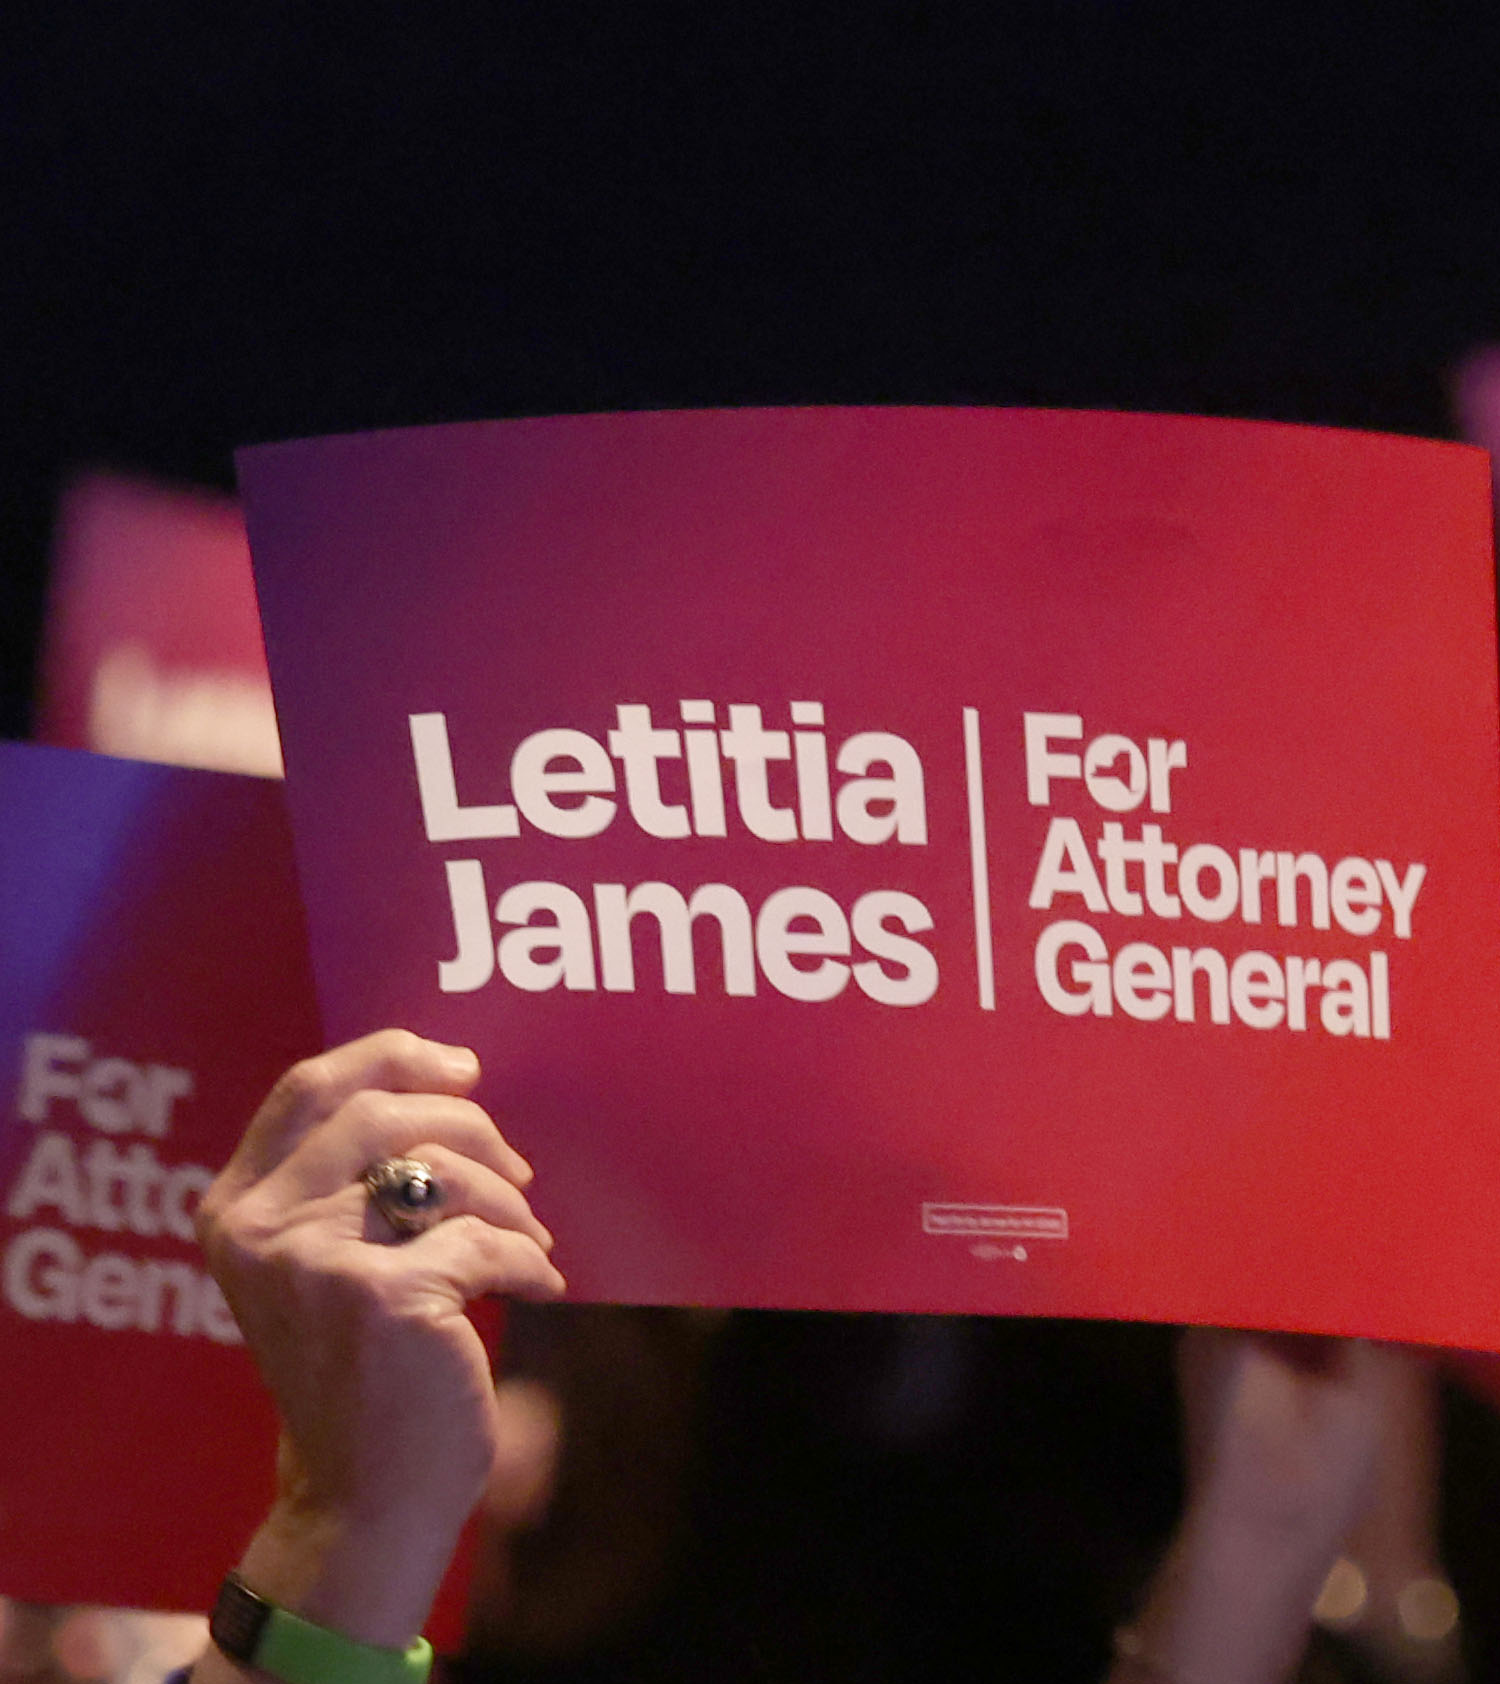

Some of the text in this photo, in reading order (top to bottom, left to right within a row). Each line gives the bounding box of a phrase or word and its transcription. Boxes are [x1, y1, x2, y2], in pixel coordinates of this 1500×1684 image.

[409, 699, 927, 846] Letitia
[1023, 711, 1187, 814] For
[438, 860, 939, 1007] James
[1028, 818, 1426, 940] Attorney
[1034, 920, 1391, 1040] General
[19, 1033, 196, 1138] For
[6, 1130, 216, 1243] Atto
[2, 1226, 249, 1345] Gene
